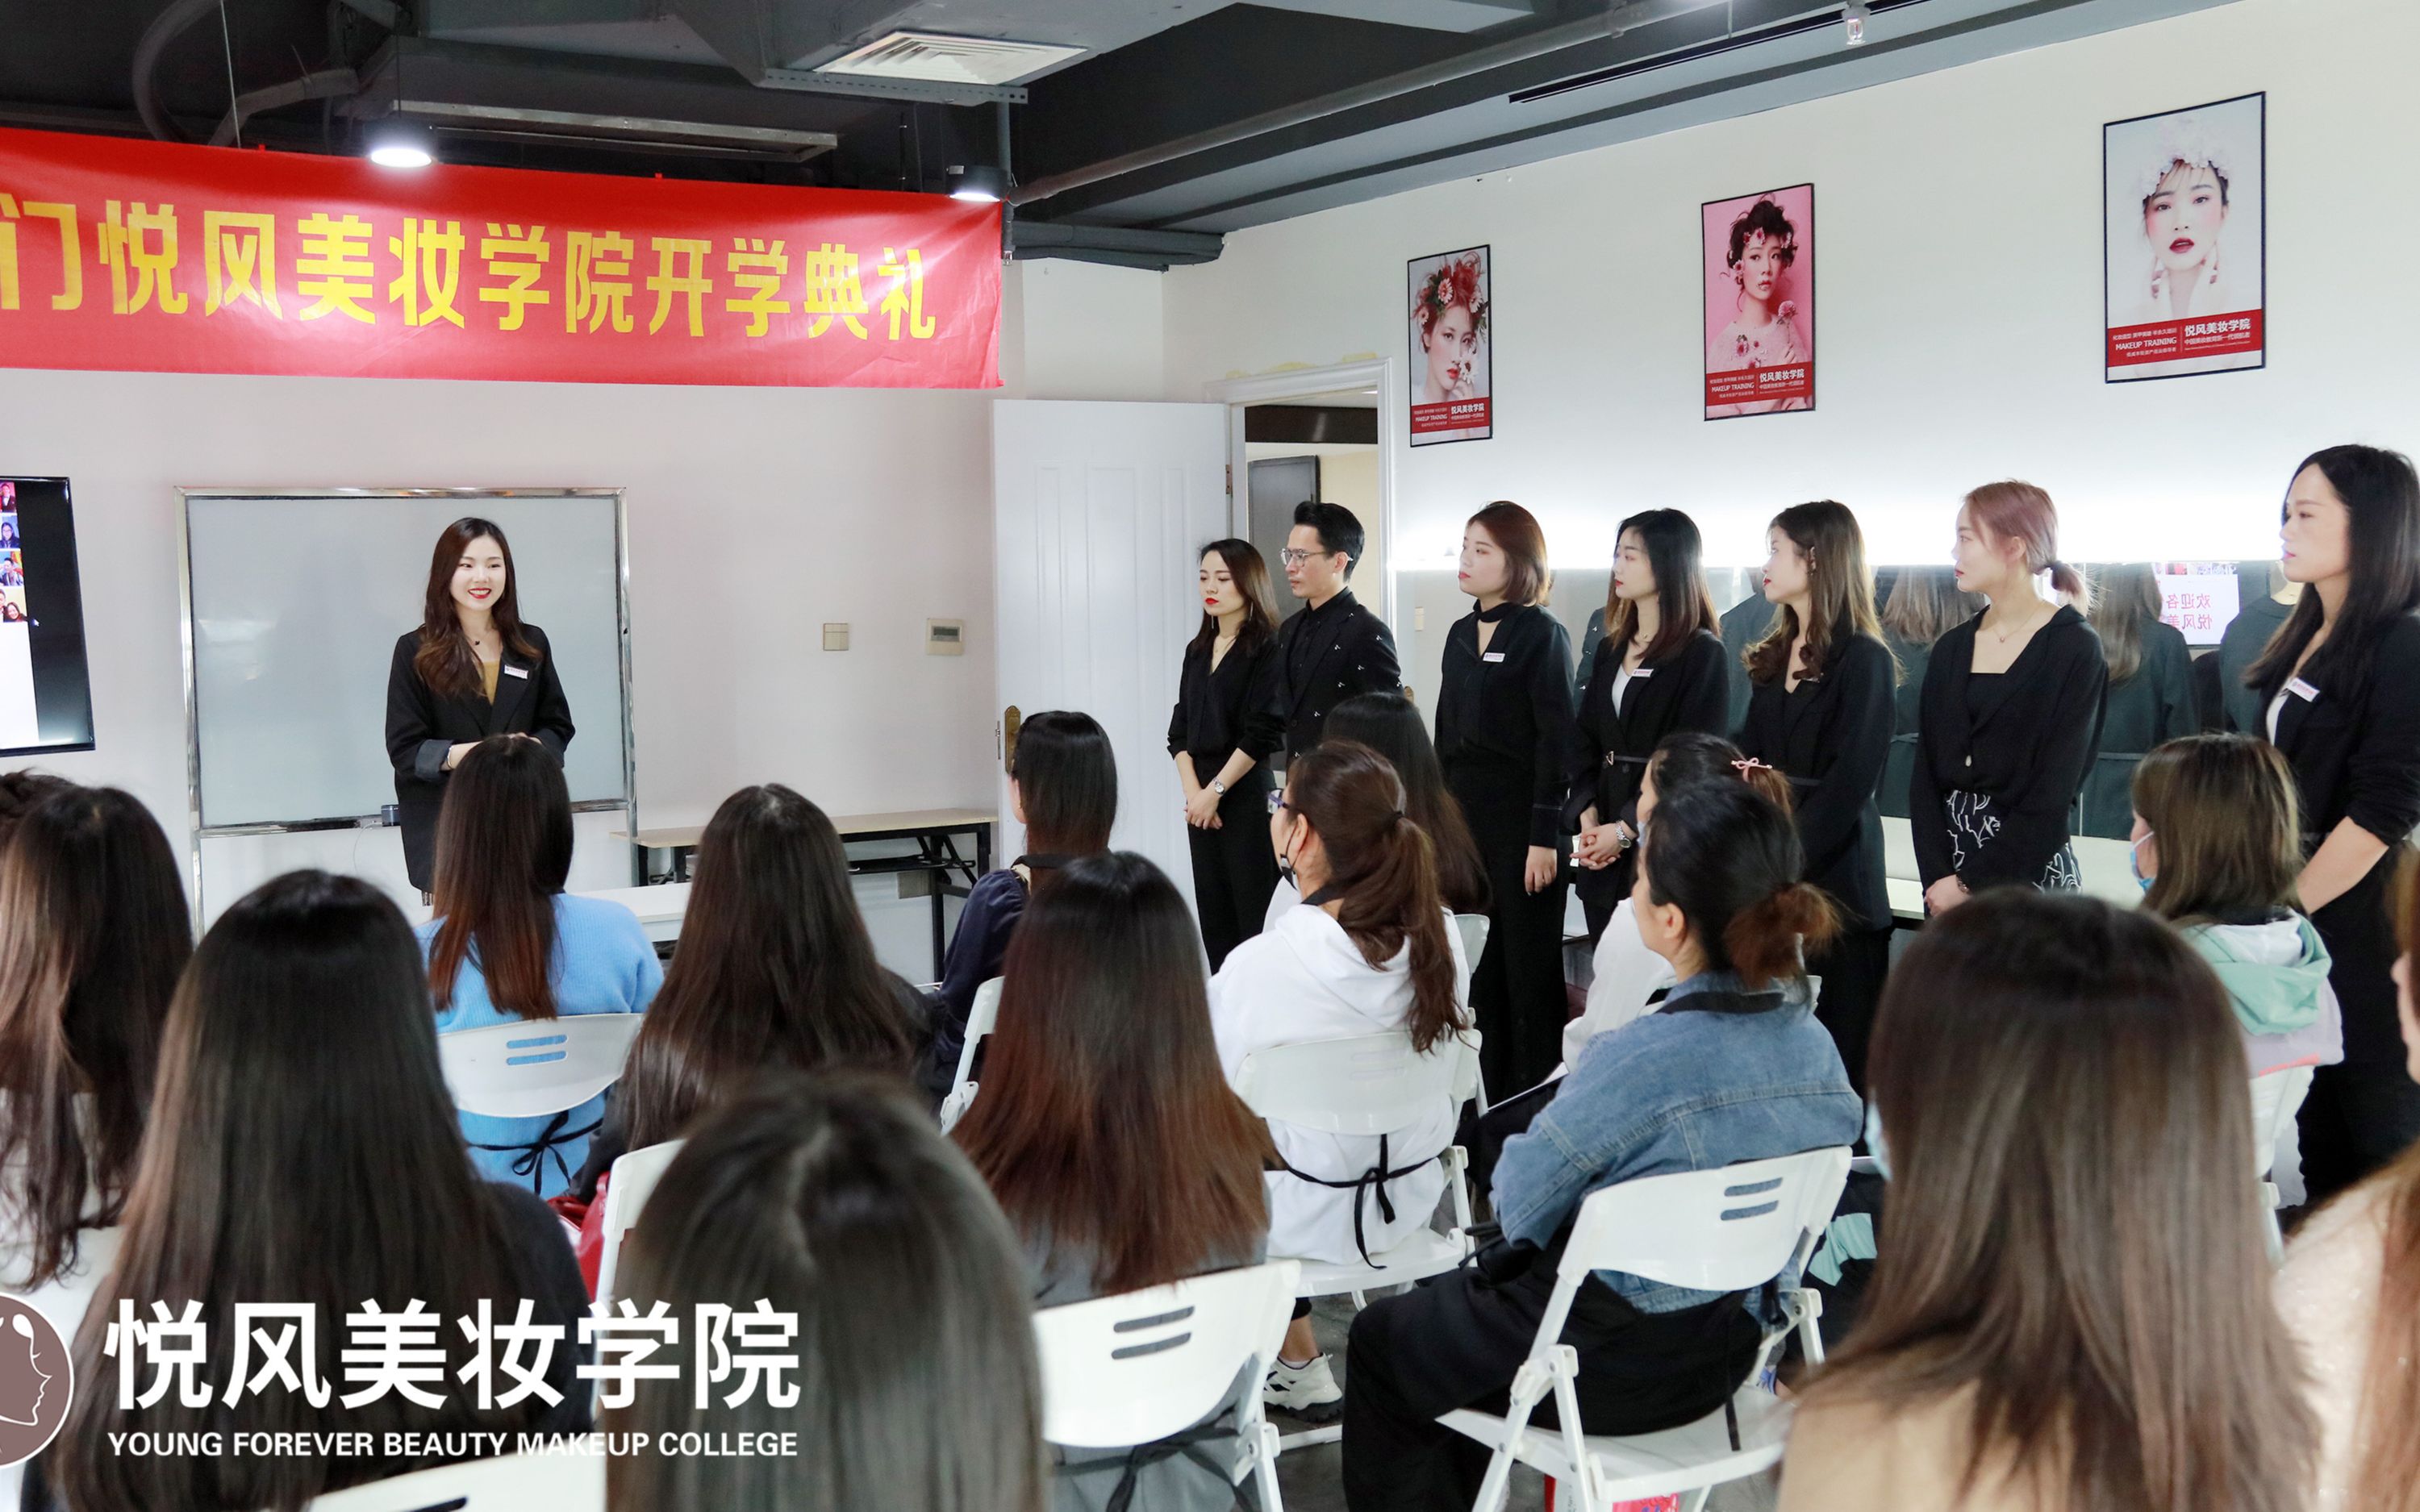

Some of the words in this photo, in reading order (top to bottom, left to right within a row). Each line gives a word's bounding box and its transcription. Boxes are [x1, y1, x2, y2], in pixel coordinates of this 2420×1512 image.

[2184, 318, 2251, 337] 悦风美妆学院
[2115, 341, 2143, 350] MAKEUP
[2144, 337, 2177, 347] TRAINING
[1759, 369, 1805, 383] 悦风美妆学院
[1711, 385, 1730, 393] MAKEUP
[1731, 382, 1754, 390] TRAINING
